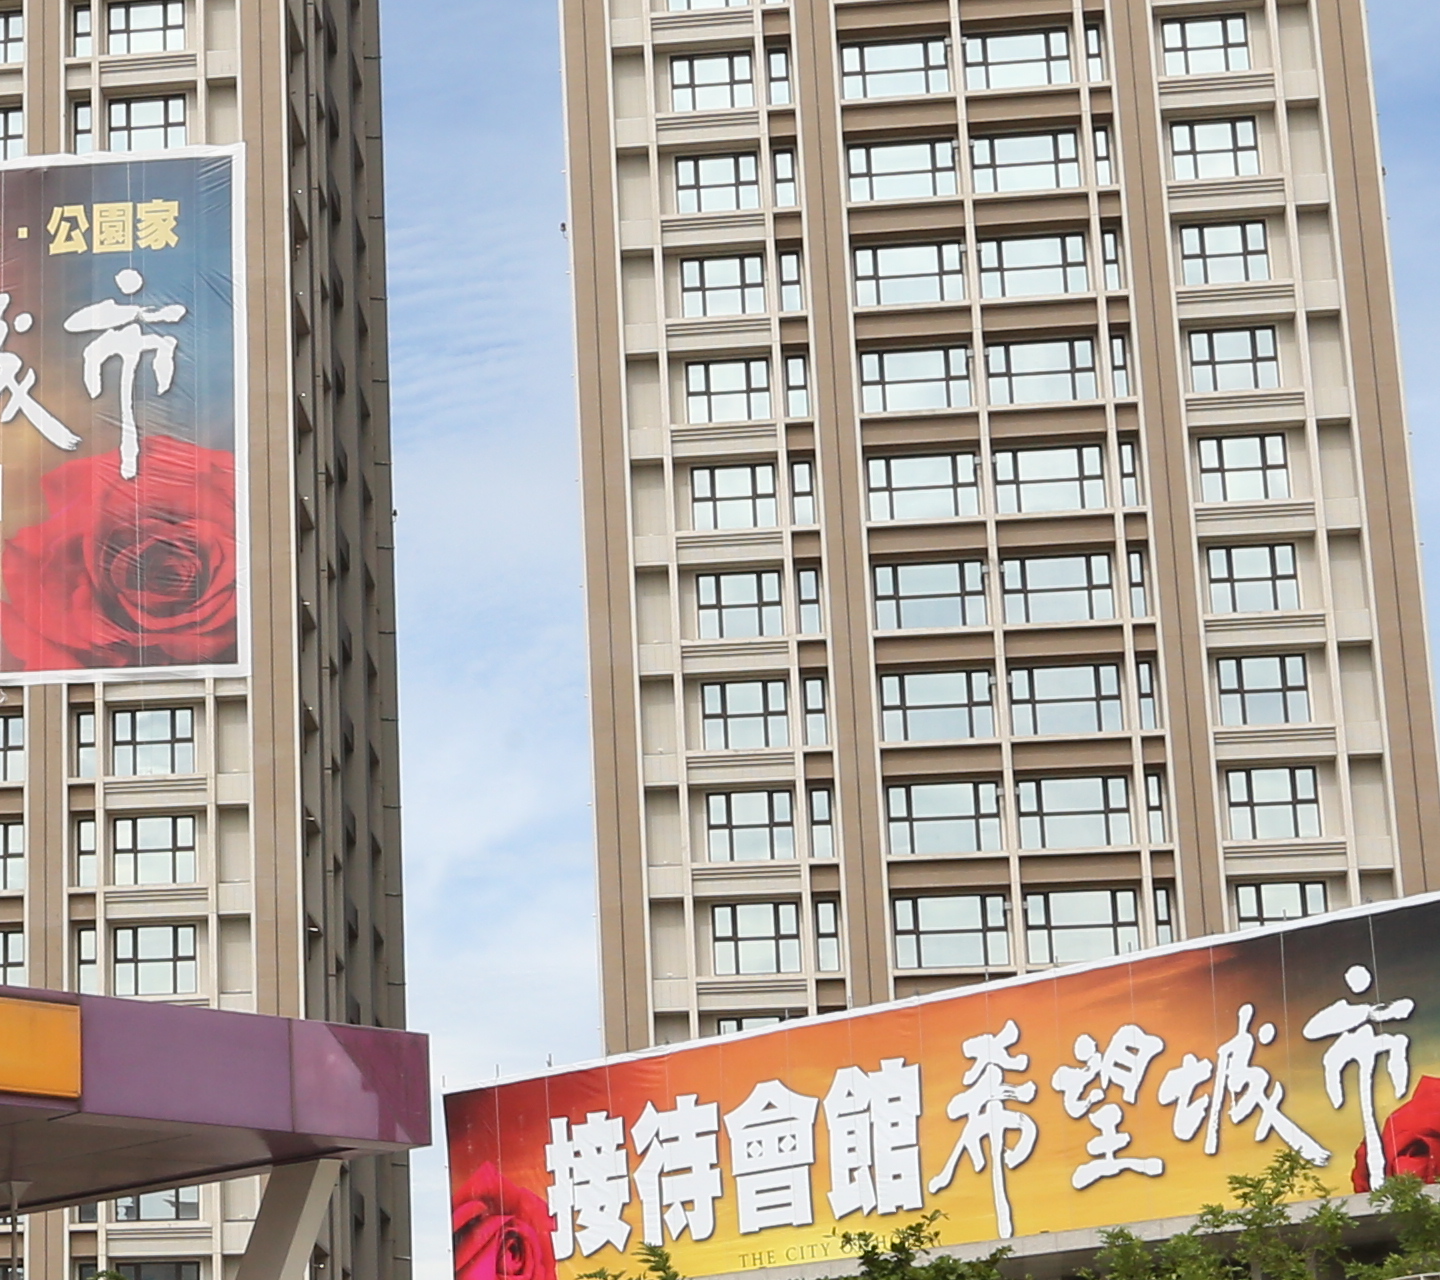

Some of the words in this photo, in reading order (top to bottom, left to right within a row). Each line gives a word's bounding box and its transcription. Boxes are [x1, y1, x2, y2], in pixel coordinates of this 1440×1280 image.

[545, 1057, 923, 1261] 接待會館
[927, 964, 1416, 1239] 希望城市
[739, 1249, 777, 1268] THE
[785, 1242, 832, 1262] CITY
